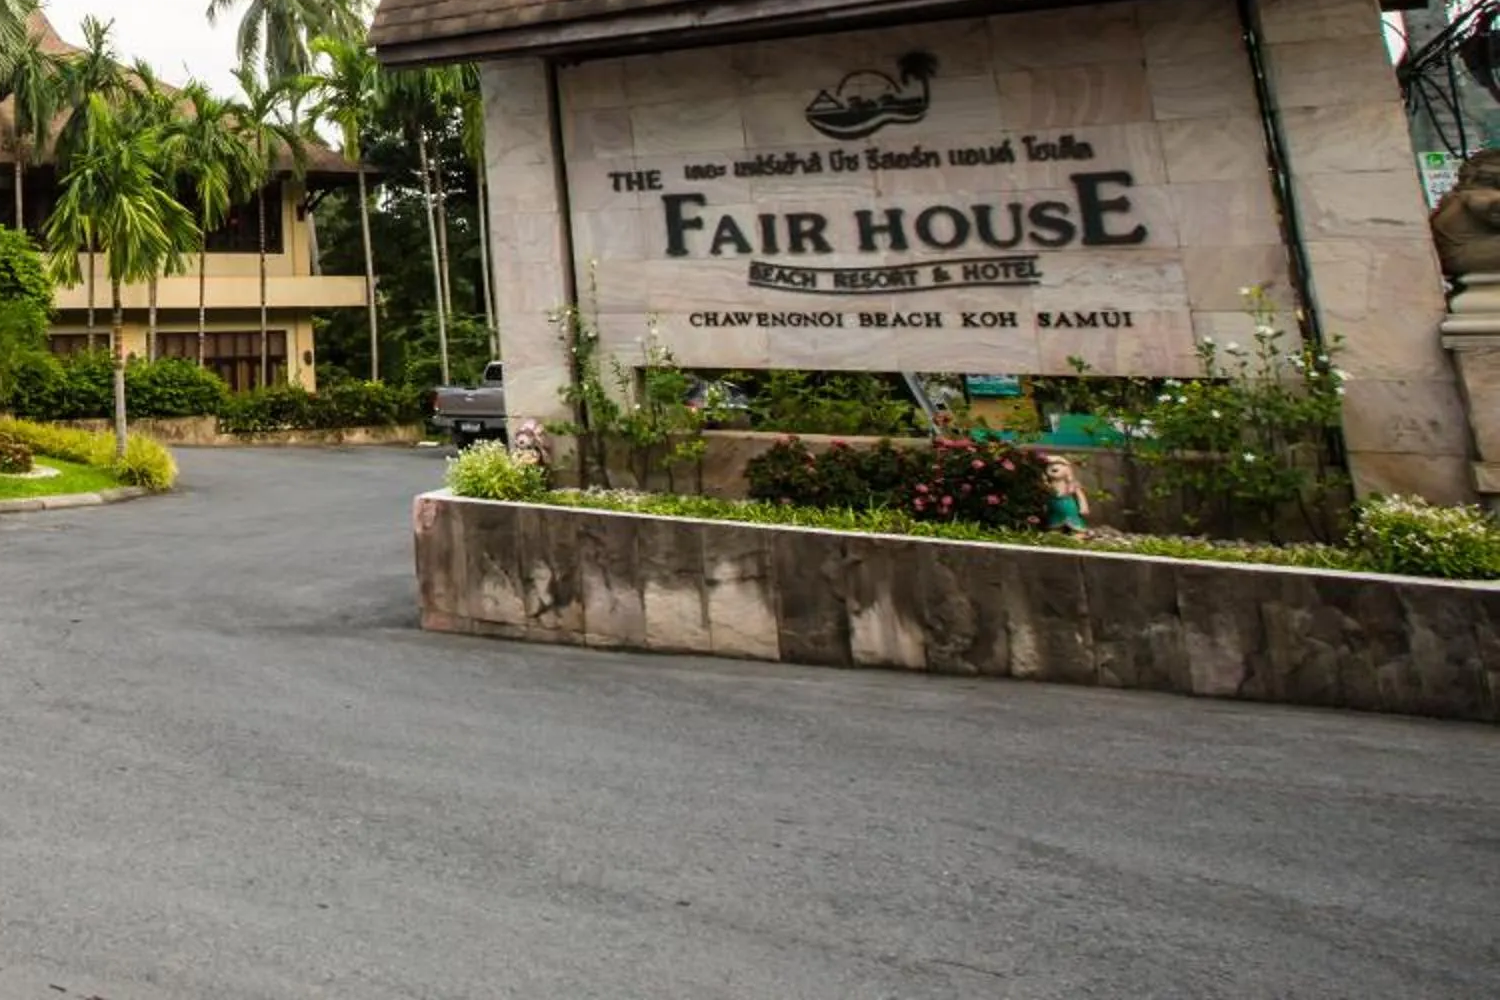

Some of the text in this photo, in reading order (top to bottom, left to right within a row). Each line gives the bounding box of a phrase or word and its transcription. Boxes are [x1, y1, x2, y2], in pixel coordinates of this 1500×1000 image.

[608, 170, 662, 192] THE
[662, 171, 1147, 256] FAIR HOUSE
[750, 260, 1043, 289] BEACH RESORT & HOTEL
[689, 310, 1133, 328] CHAWENGNOI BEACH KOH SAMUI
